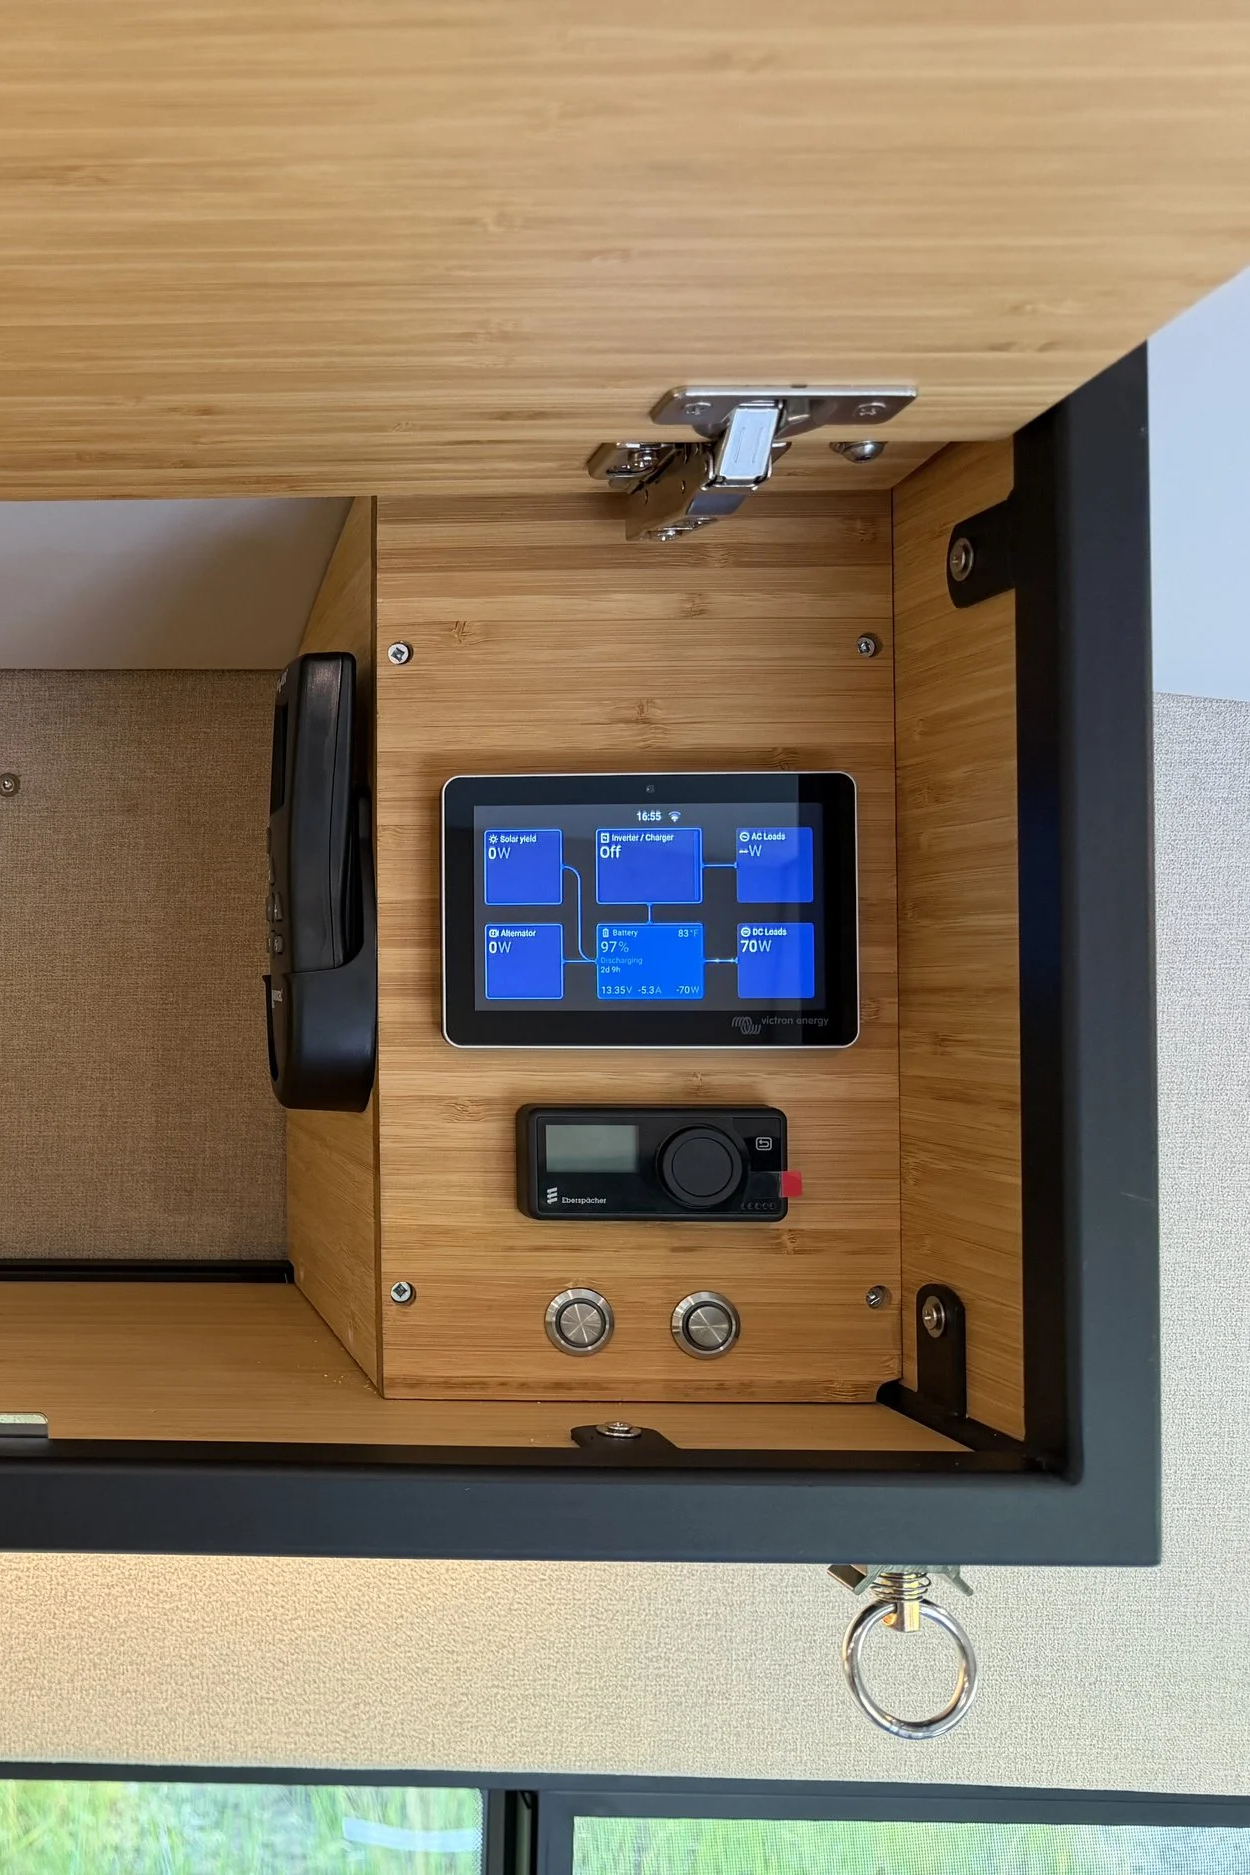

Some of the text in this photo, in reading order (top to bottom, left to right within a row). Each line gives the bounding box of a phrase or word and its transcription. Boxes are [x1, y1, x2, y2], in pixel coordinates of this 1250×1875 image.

[636, 810, 662, 821] 16:55
[499, 834, 537, 844] Solar yield
[611, 833, 639, 842] Inverter
[645, 833, 674, 843] Charger
[751, 831, 786, 841] AC Loads
[599, 845, 622, 859] Off
[500, 928, 537, 938] Alternator
[612, 929, 638, 938] Battery
[752, 927, 787, 936] DC Loads
[740, 939, 772, 953] 70W
[600, 957, 643, 965] Discharging
[600, 966, 621, 974] 2d 9h
[761, 1016, 829, 1027] victron energy
